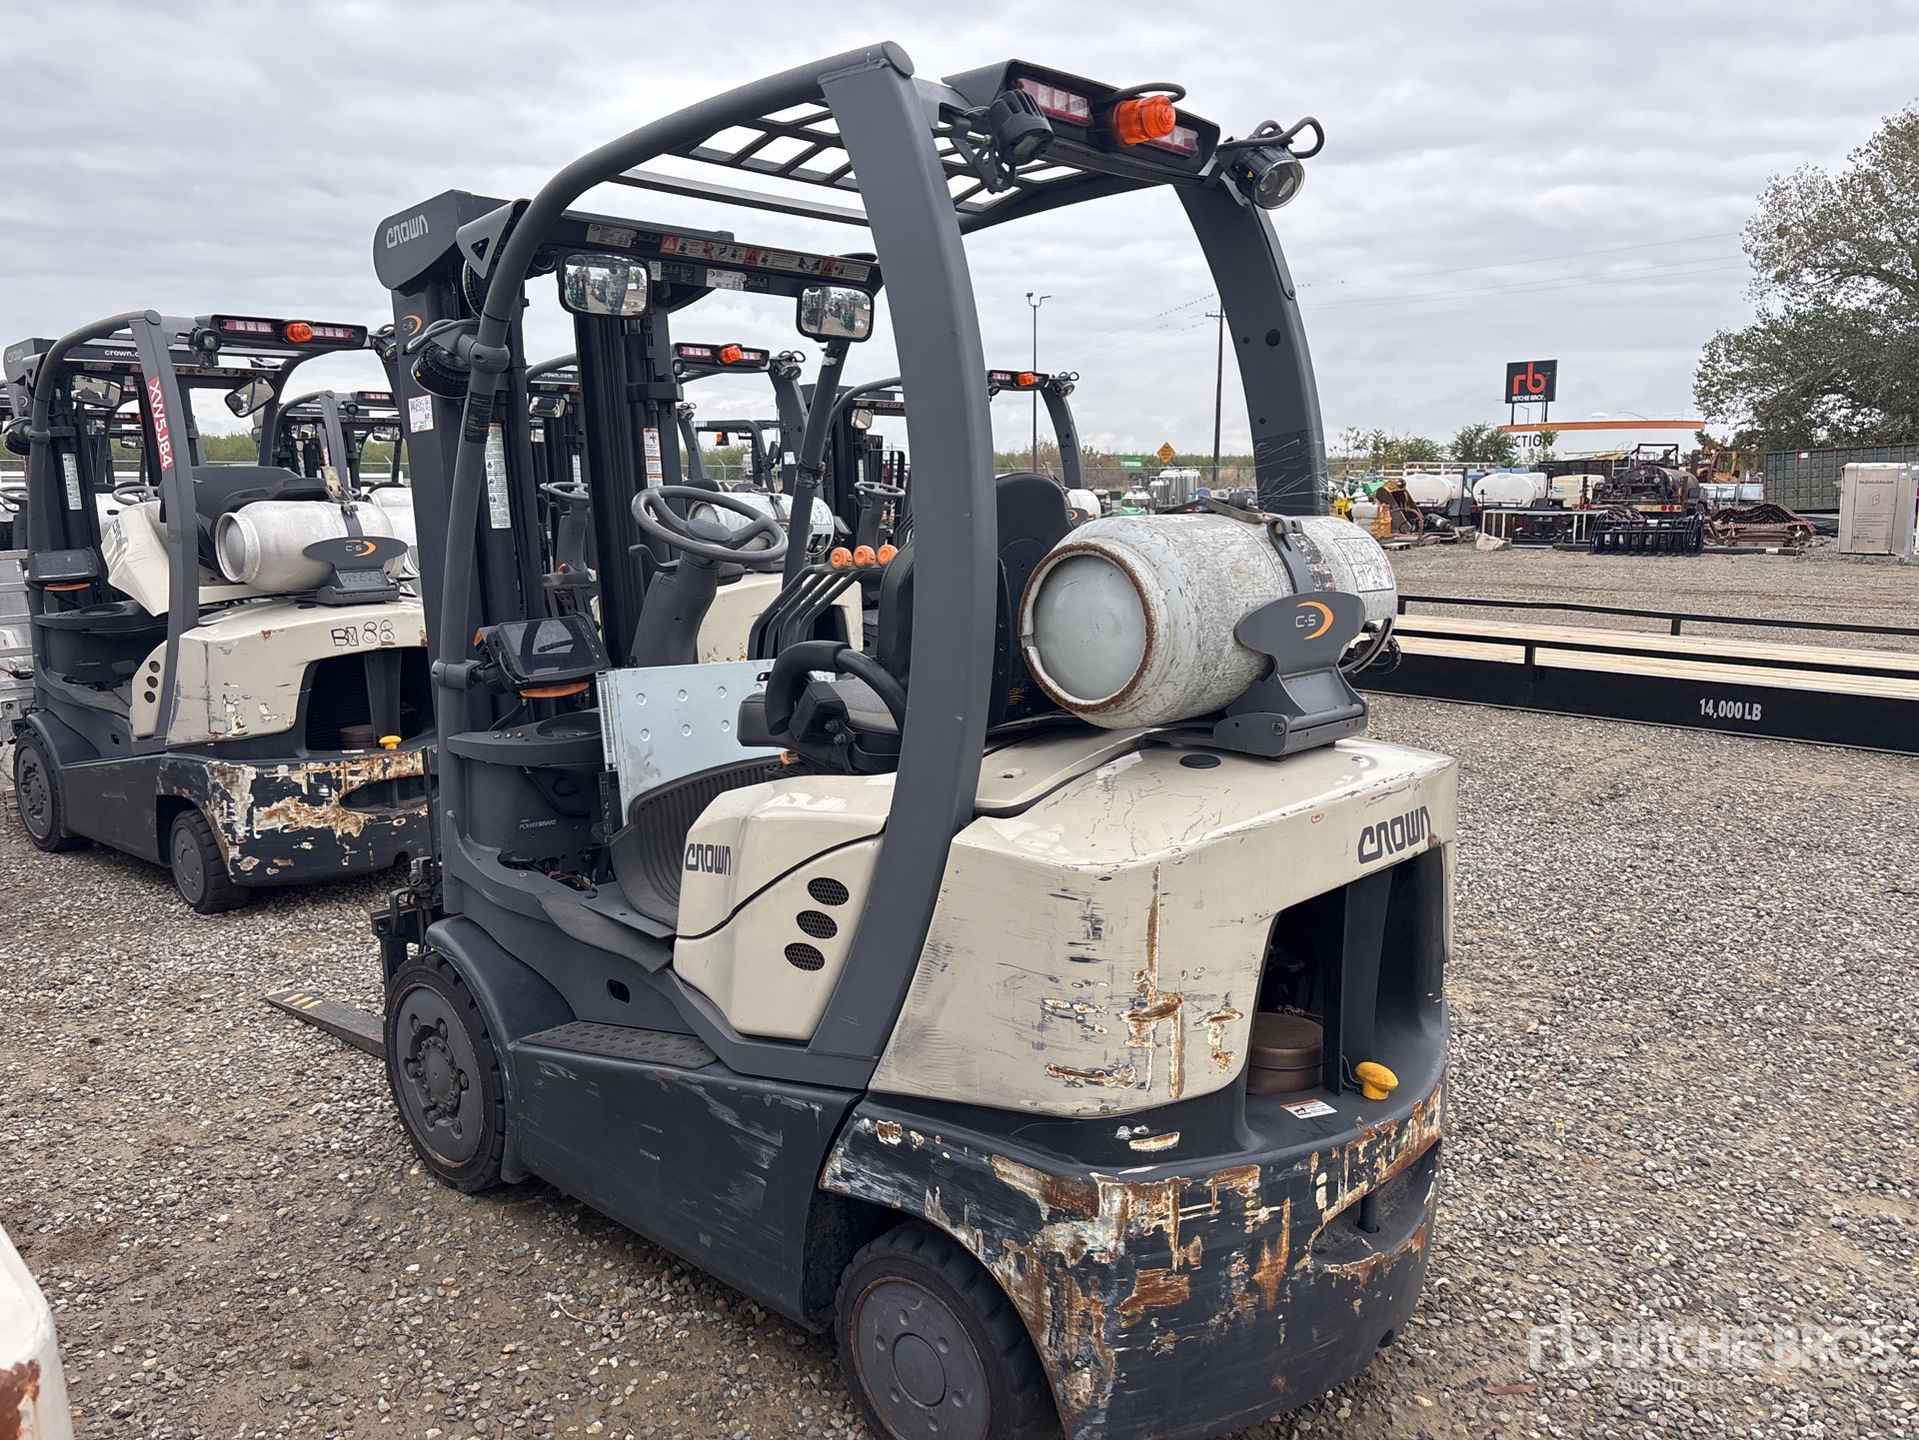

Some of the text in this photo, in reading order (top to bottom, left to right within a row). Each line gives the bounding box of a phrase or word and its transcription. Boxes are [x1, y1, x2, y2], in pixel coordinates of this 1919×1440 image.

[386, 214, 429, 249] CROWN
[104, 348, 140, 357] crown.c
[1513, 362, 1546, 394] rb
[1358, 805, 1431, 864] CROWN
[685, 843, 731, 876] CROWN
